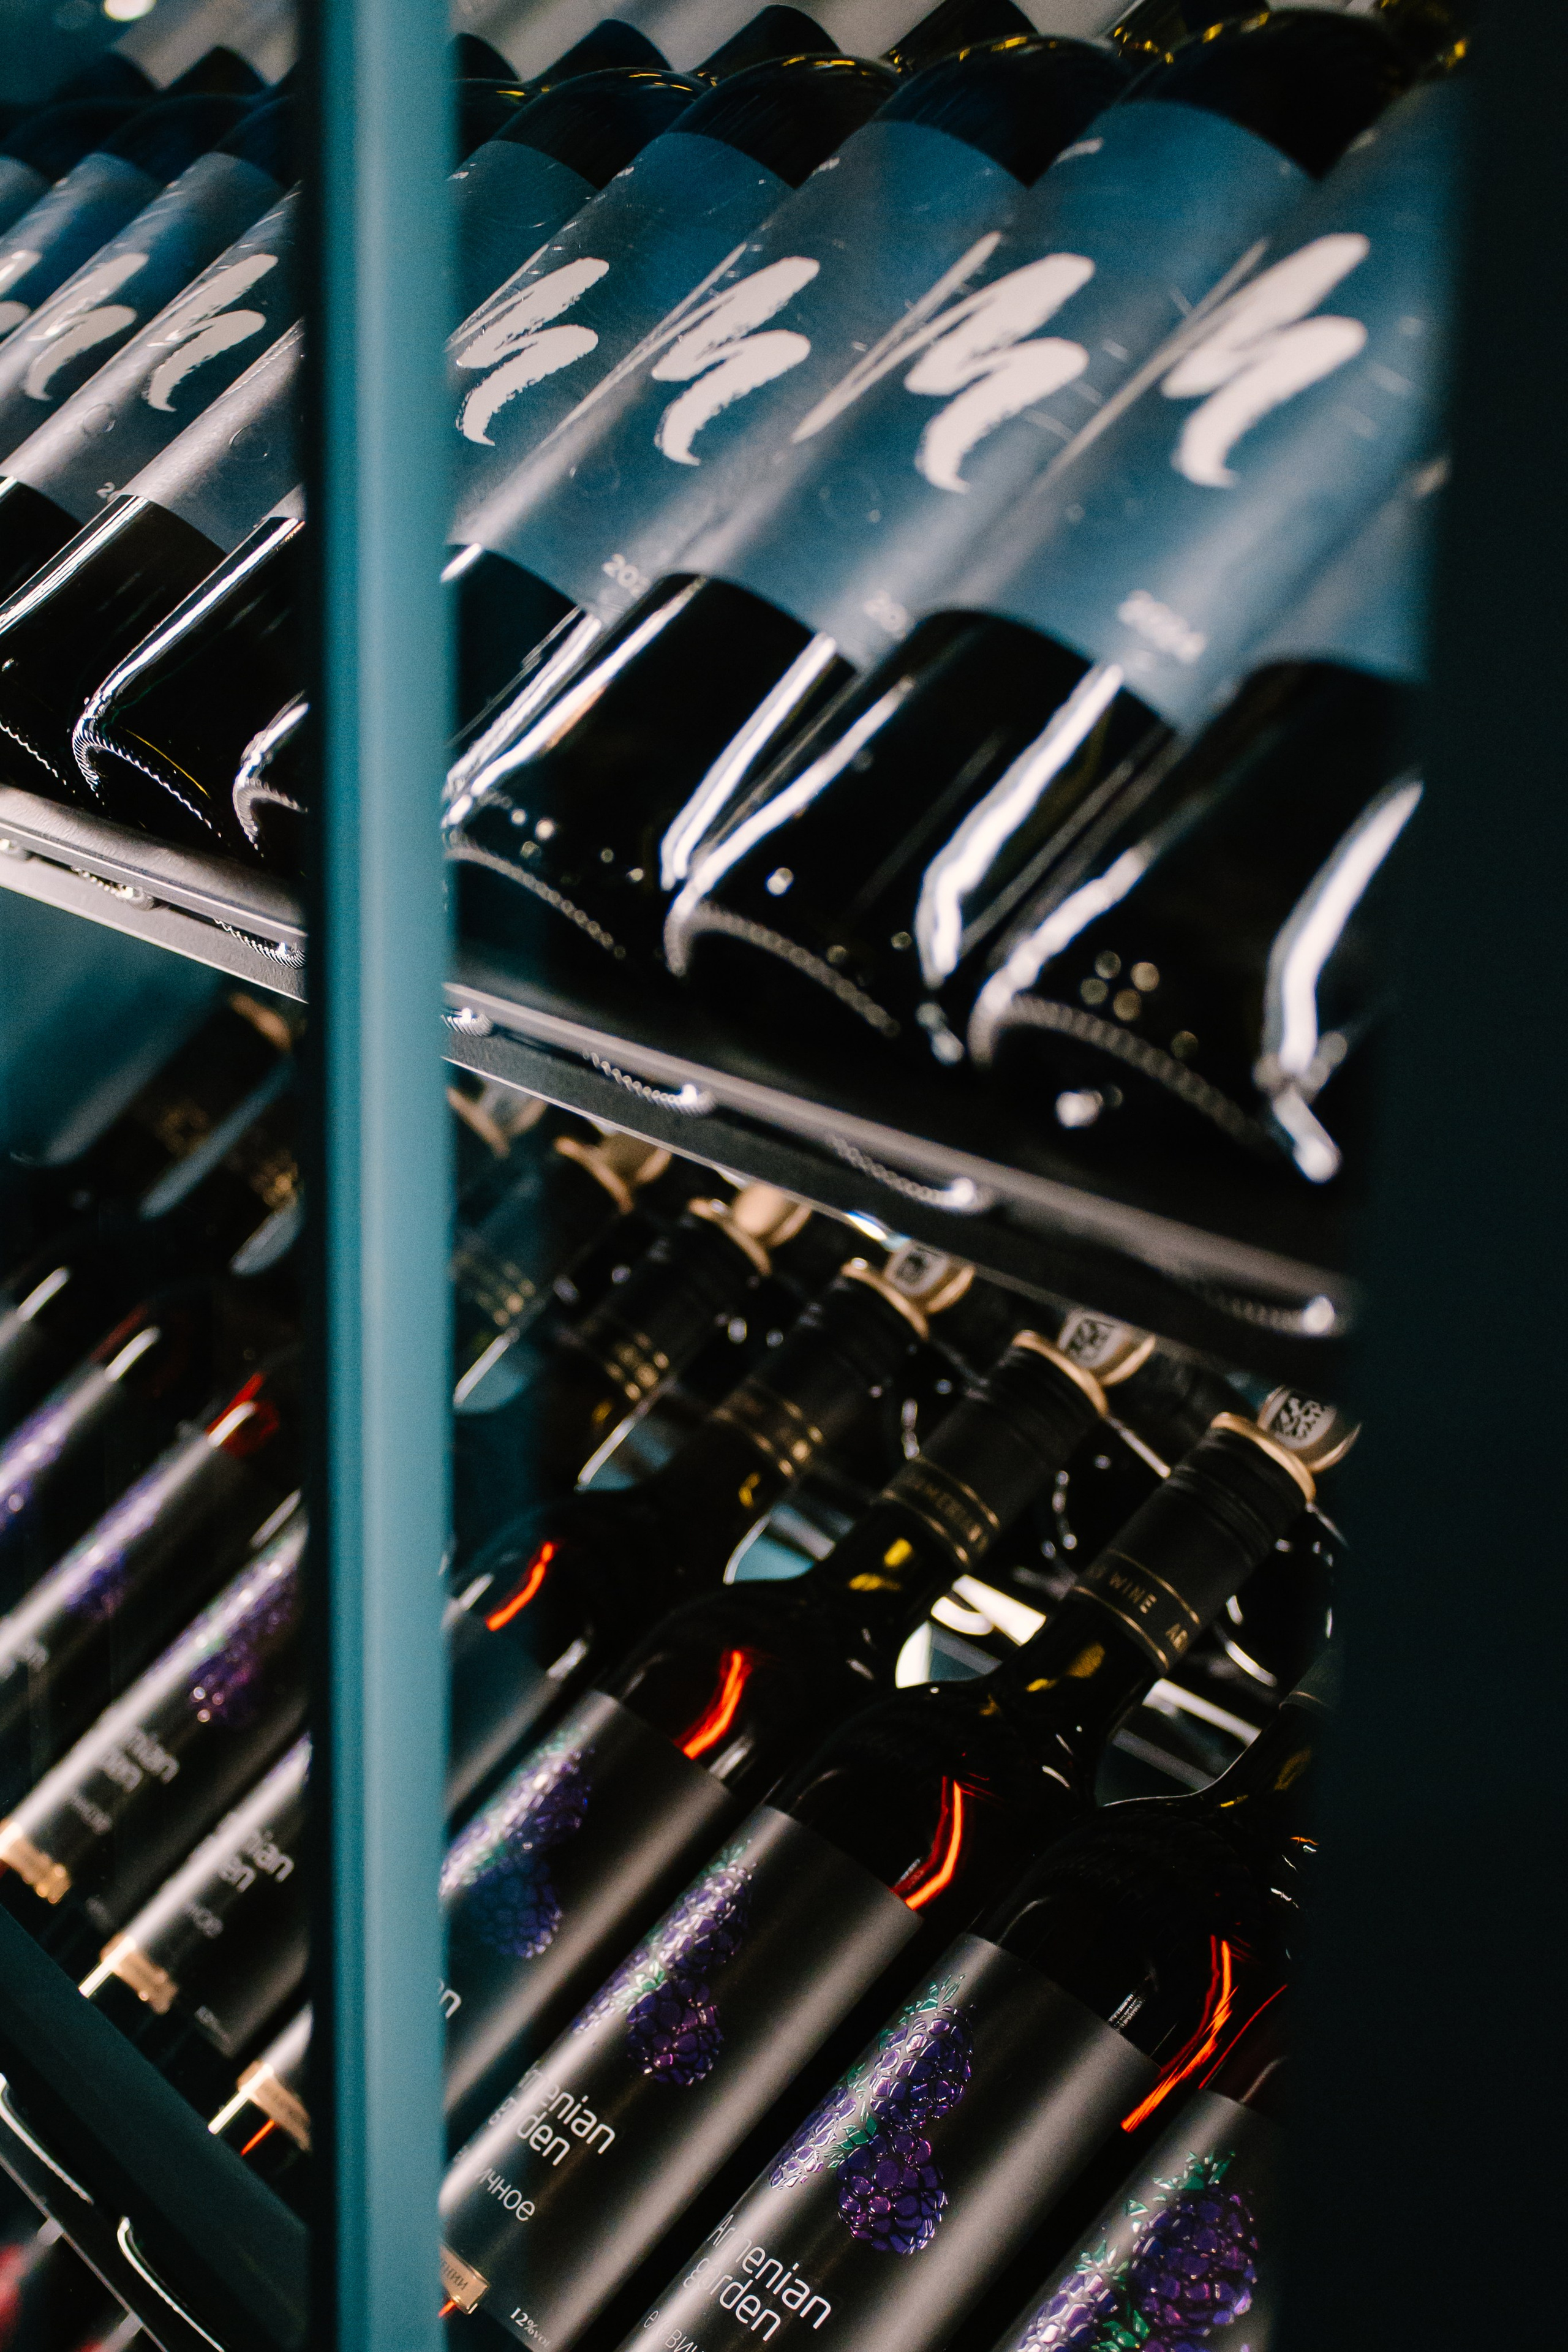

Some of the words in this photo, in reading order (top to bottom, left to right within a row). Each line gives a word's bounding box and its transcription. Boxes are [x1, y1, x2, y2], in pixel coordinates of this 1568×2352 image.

[1109, 1571, 1157, 1614] WINE
[683, 2257, 781, 2342] garden
[706, 2214, 831, 2329] Armenian
